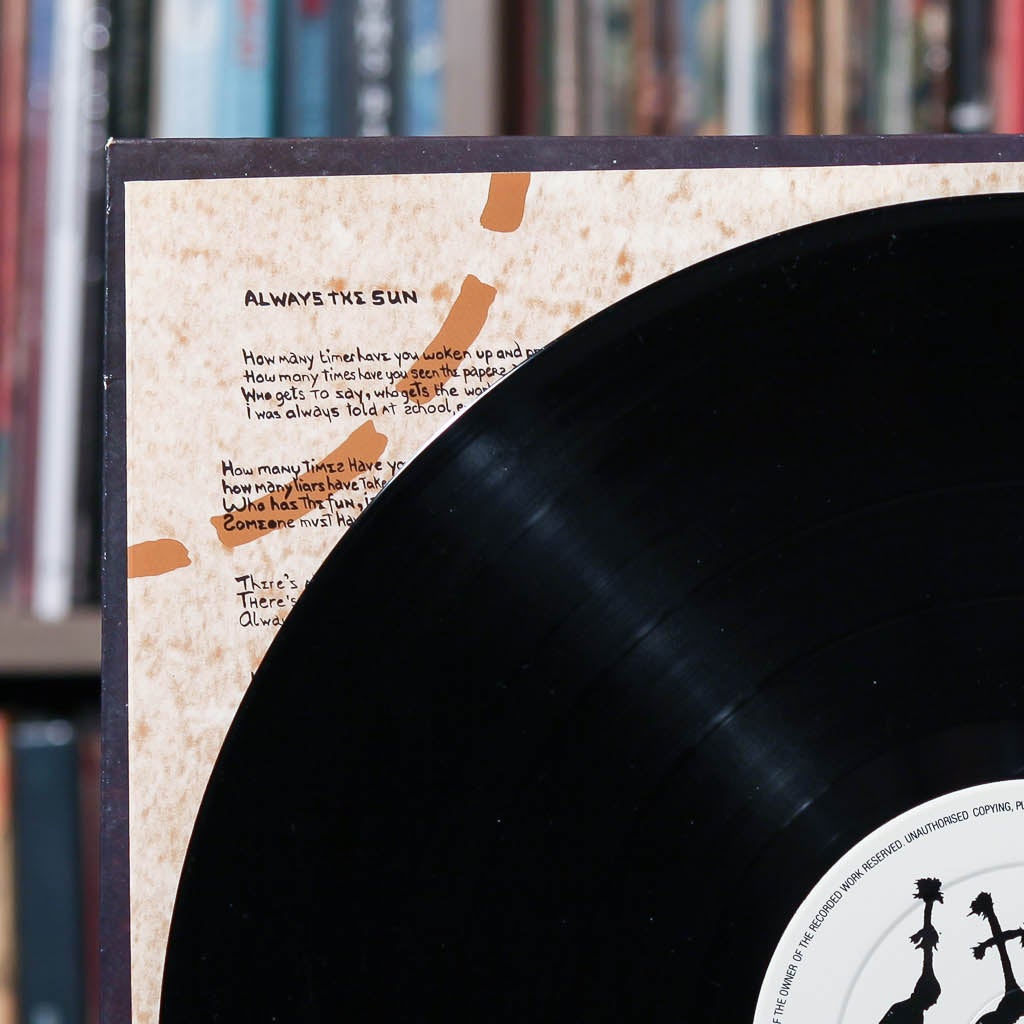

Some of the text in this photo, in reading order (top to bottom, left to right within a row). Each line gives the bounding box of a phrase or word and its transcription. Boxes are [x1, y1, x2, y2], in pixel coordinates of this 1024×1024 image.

[244, 289, 418, 307] ALWAYS THE SUN
[242, 348, 275, 366] How
[394, 352, 420, 368] you
[423, 345, 472, 361] woken
[475, 349, 493, 365] up
[243, 369, 276, 383] How
[357, 367, 384, 381] have
[385, 371, 409, 385] you
[411, 368, 439, 380] seen
[374, 386, 400, 398] who
[434, 382, 460, 397] the
[255, 410, 282, 420] was
[286, 403, 340, 423] always
[346, 402, 378, 417] told
[221, 459, 254, 477] How
[221, 479, 252, 494] how
[255, 480, 294, 499] many
[327, 475, 360, 491] have
[223, 496, 266, 513] Who
[270, 496, 299, 512] has
[972, 801, 1014, 818] COPYING,
[904, 810, 970, 843] UNAUTHORISED
[861, 839, 906, 873] RESERVED.
[840, 868, 865, 893] WORK
[808, 890, 844, 934] RECORDED
[798, 931, 815, 949] THE
[792, 948, 804, 961] OF
[779, 963, 798, 997] OWNER
[773, 997, 787, 1016] THE
